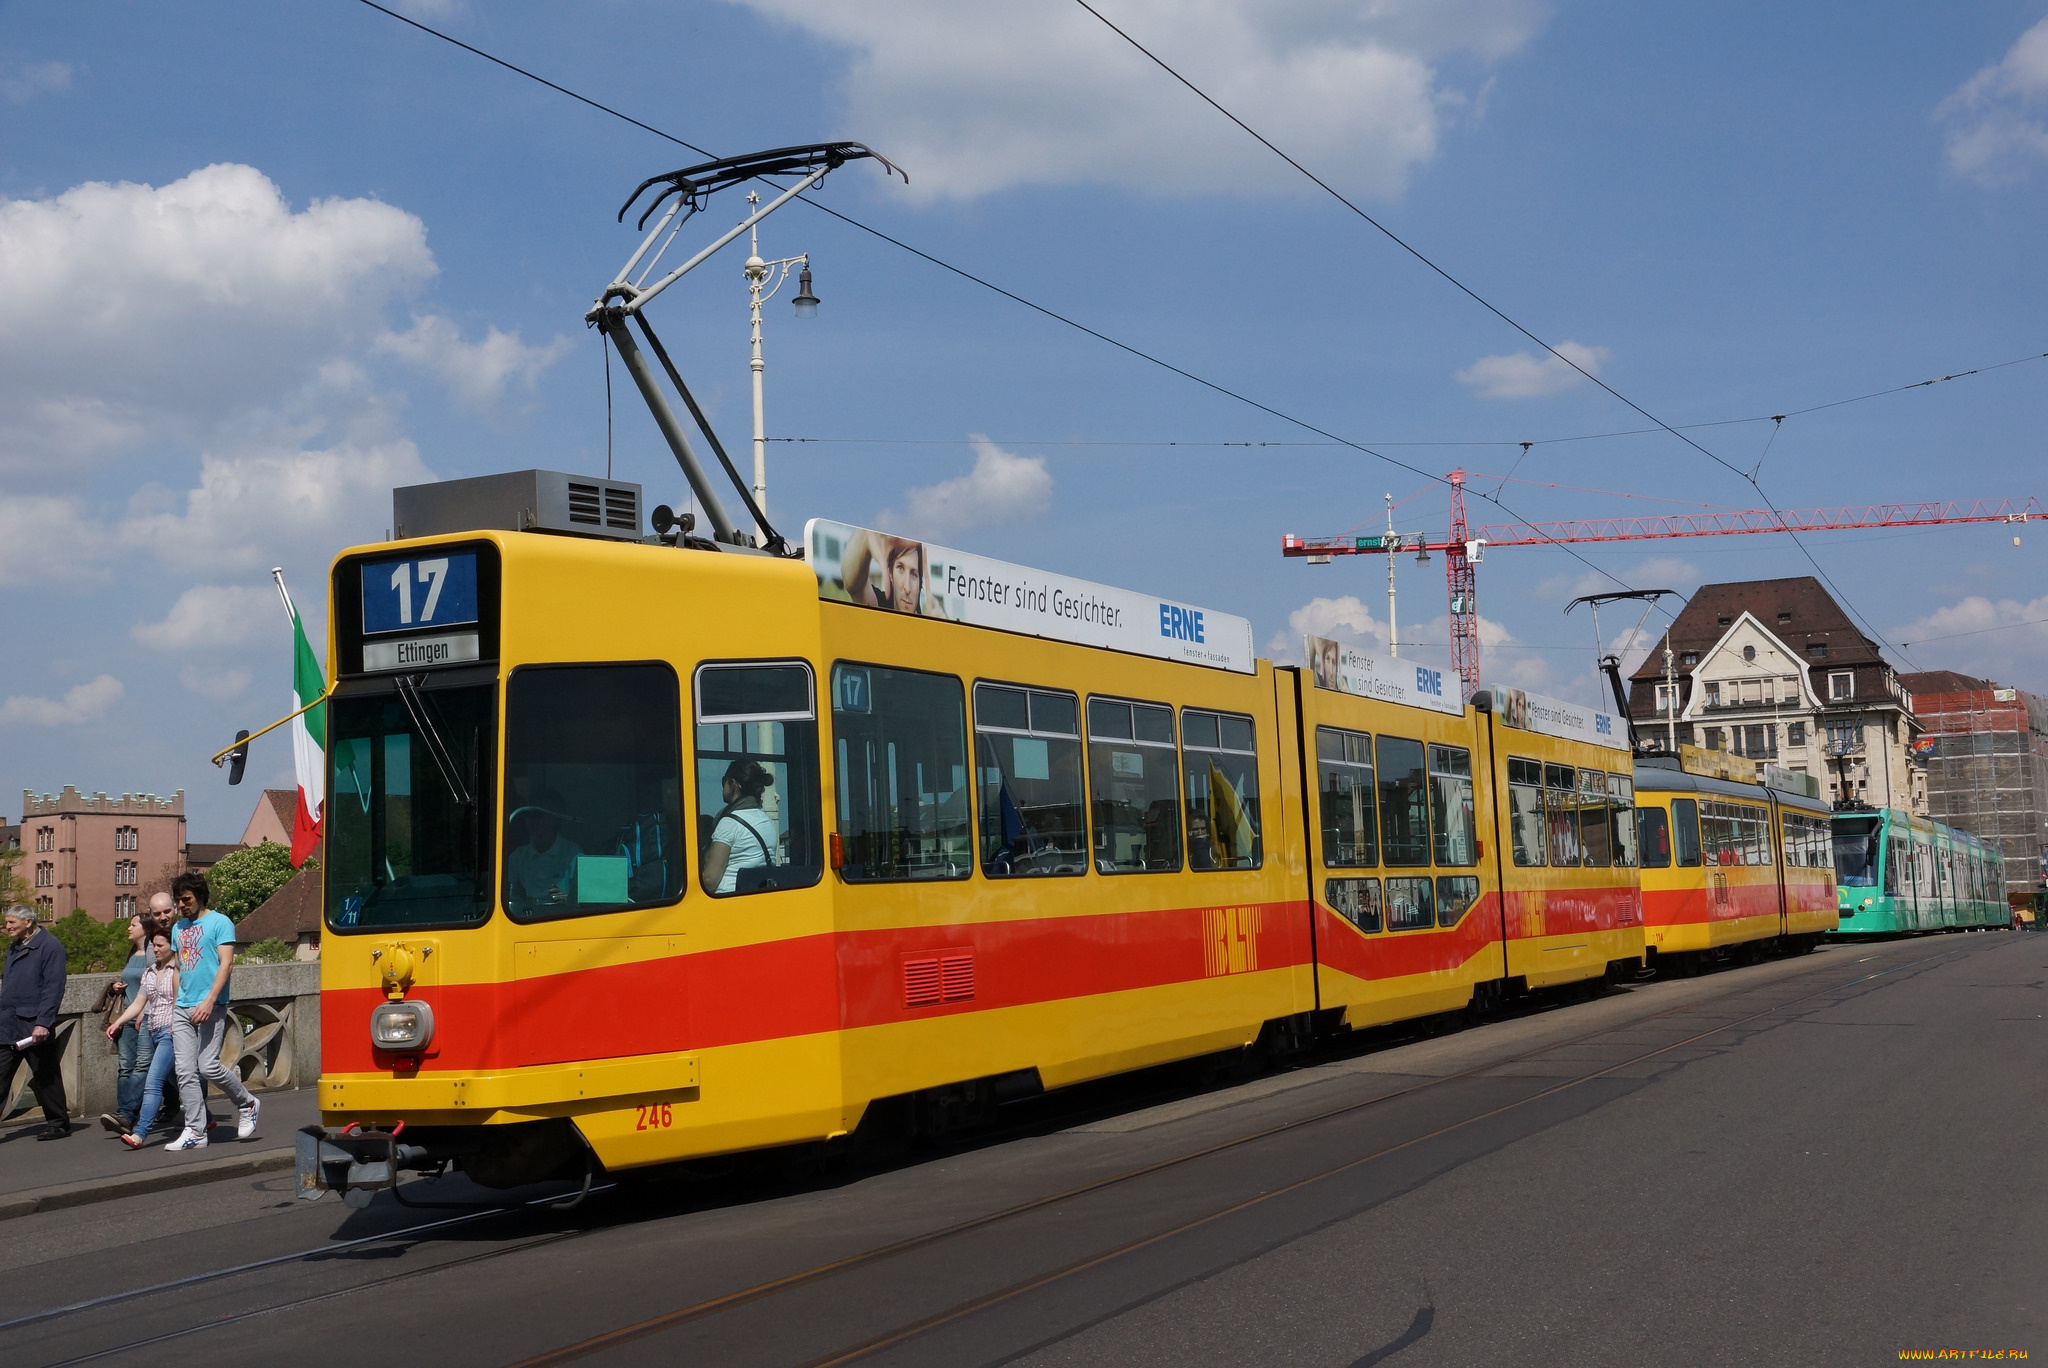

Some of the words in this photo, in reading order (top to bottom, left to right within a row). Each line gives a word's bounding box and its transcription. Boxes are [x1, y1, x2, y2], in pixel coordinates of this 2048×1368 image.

[391, 558, 448, 624] 17
[947, 565, 1010, 605] Fenster
[1015, 582, 1046, 613] sind
[1053, 588, 1123, 628] Gesichter.
[1159, 603, 1205, 644] ERNE
[397, 641, 449, 664] Ettingen
[1183, 646, 1203, 658] fenster
[1207, 650, 1230, 663] fassaden
[1348, 650, 1374, 671] Fenster
[842, 674, 862, 705] 17
[1358, 675, 1372, 693] sind
[1374, 678, 1406, 700] Gesichter.
[1416, 666, 1442, 696] ERNE
[1531, 702, 1551, 721] Fenster
[1551, 706, 1561, 724] sind
[1595, 713, 1611, 735] ERNE
[1202, 906, 1262, 977] BLT
[635, 1101, 673, 1131] 246
